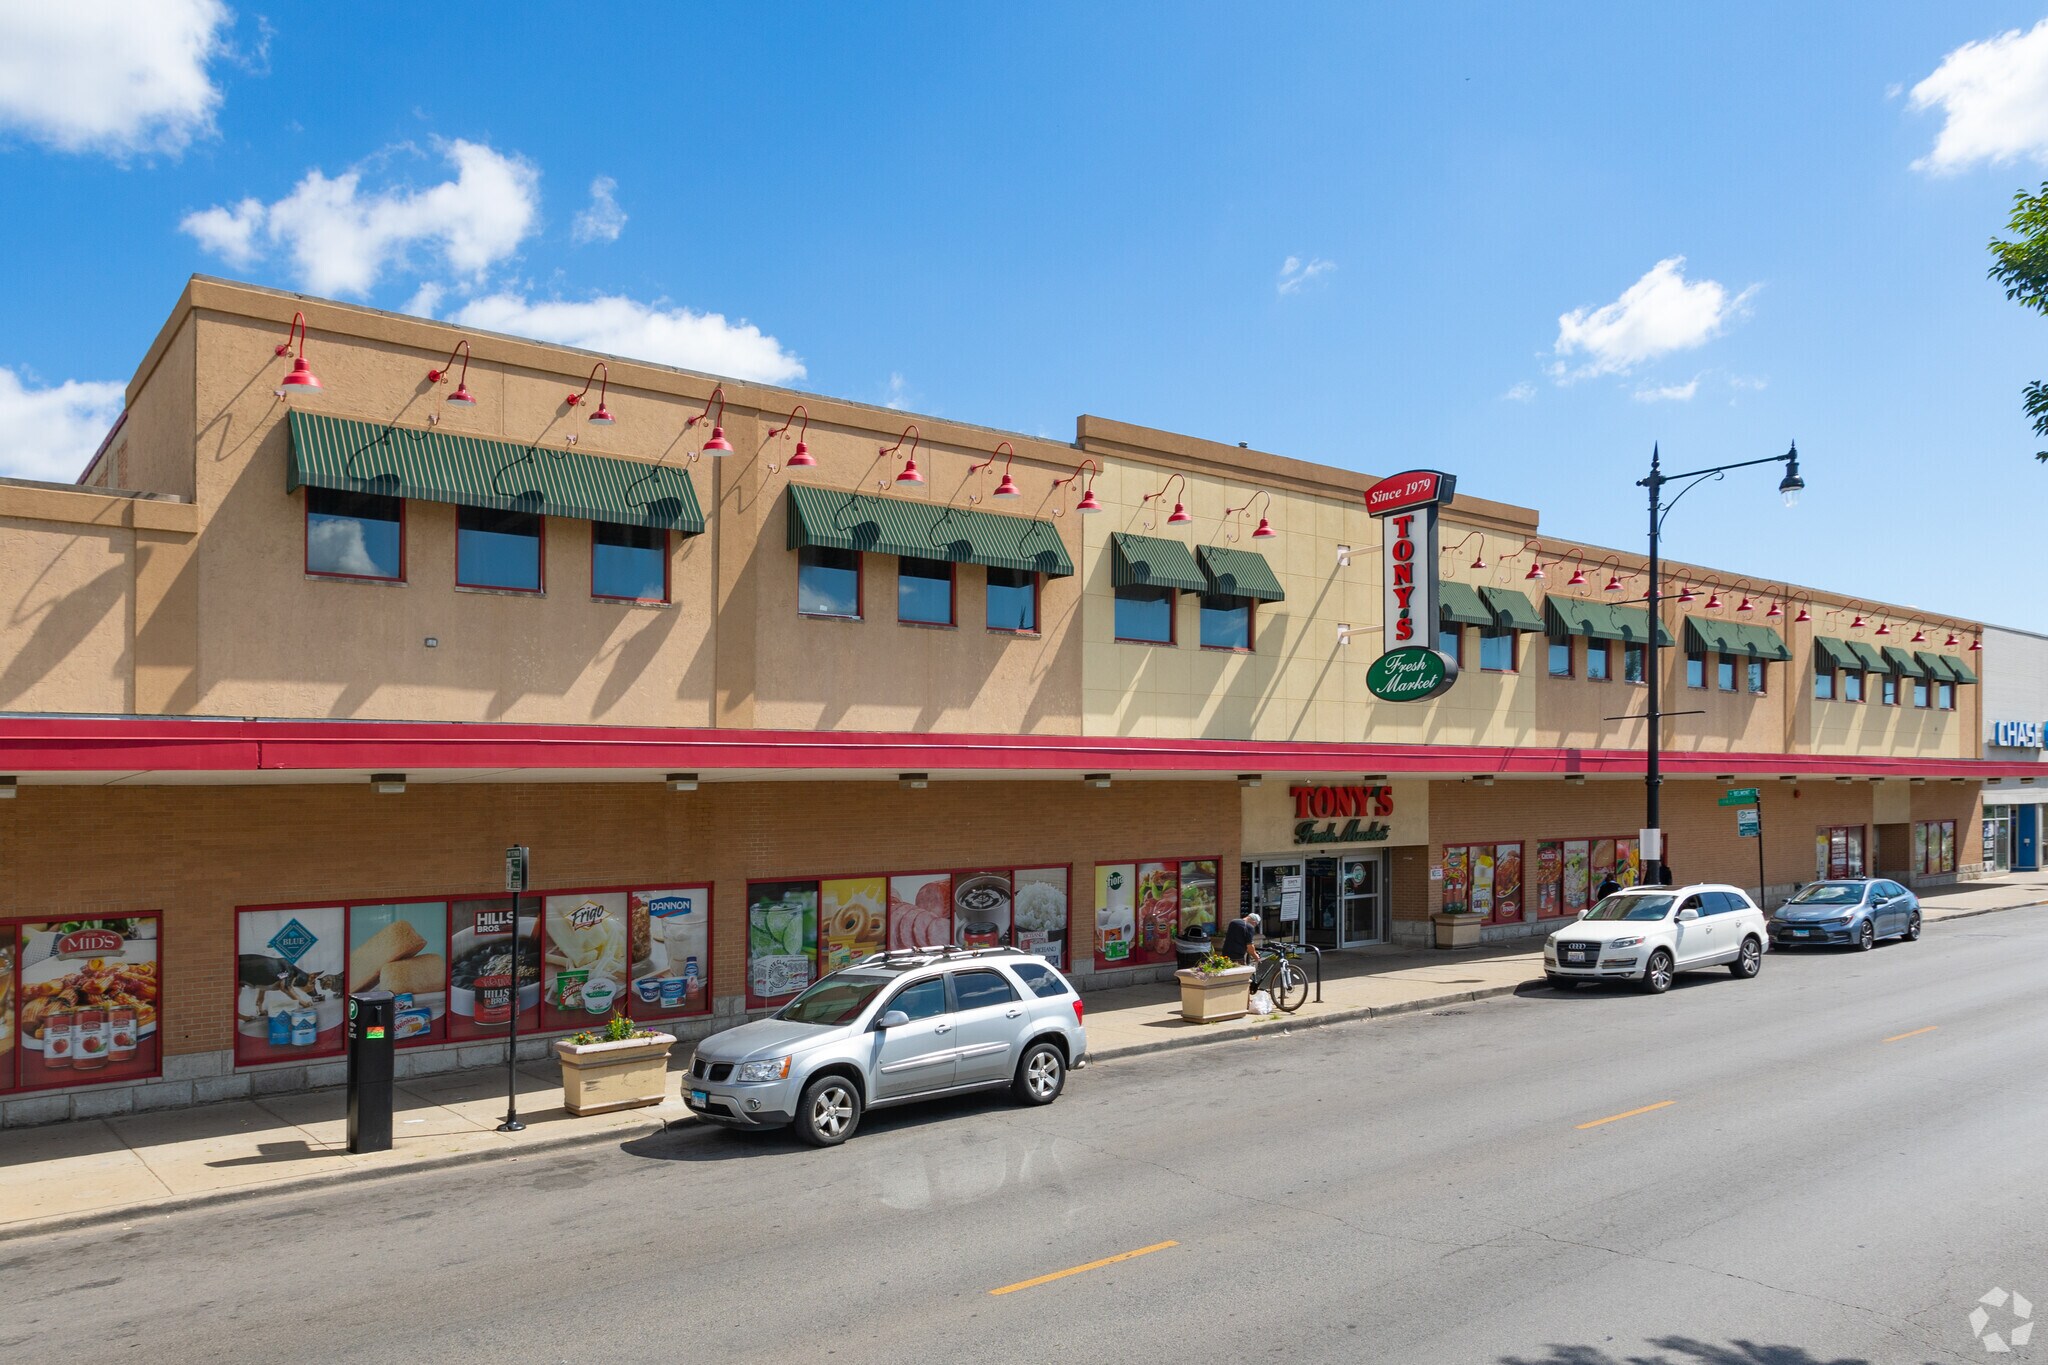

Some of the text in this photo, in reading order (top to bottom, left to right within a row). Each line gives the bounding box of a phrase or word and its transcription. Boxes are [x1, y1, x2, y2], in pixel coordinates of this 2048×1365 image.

[1370, 478, 1431, 504] Since 1979
[1392, 514, 1414, 641] TONY'S
[1384, 653, 1427, 674] Fresh
[1376, 673, 1438, 693] Market
[1995, 720, 2043, 748] CHASE
[1290, 785, 1394, 818] TONY'S
[1294, 818, 1392, 844] Fresh Market
[571, 904, 605, 927] Frigo
[650, 900, 690, 911] DANNON
[477, 911, 514, 926] HILLS
[67, 935, 115, 951] MID'S
[282, 937, 305, 946] BLUE
[1034, 945, 1056, 953] RICELAND
[484, 988, 510, 998] HILLS
